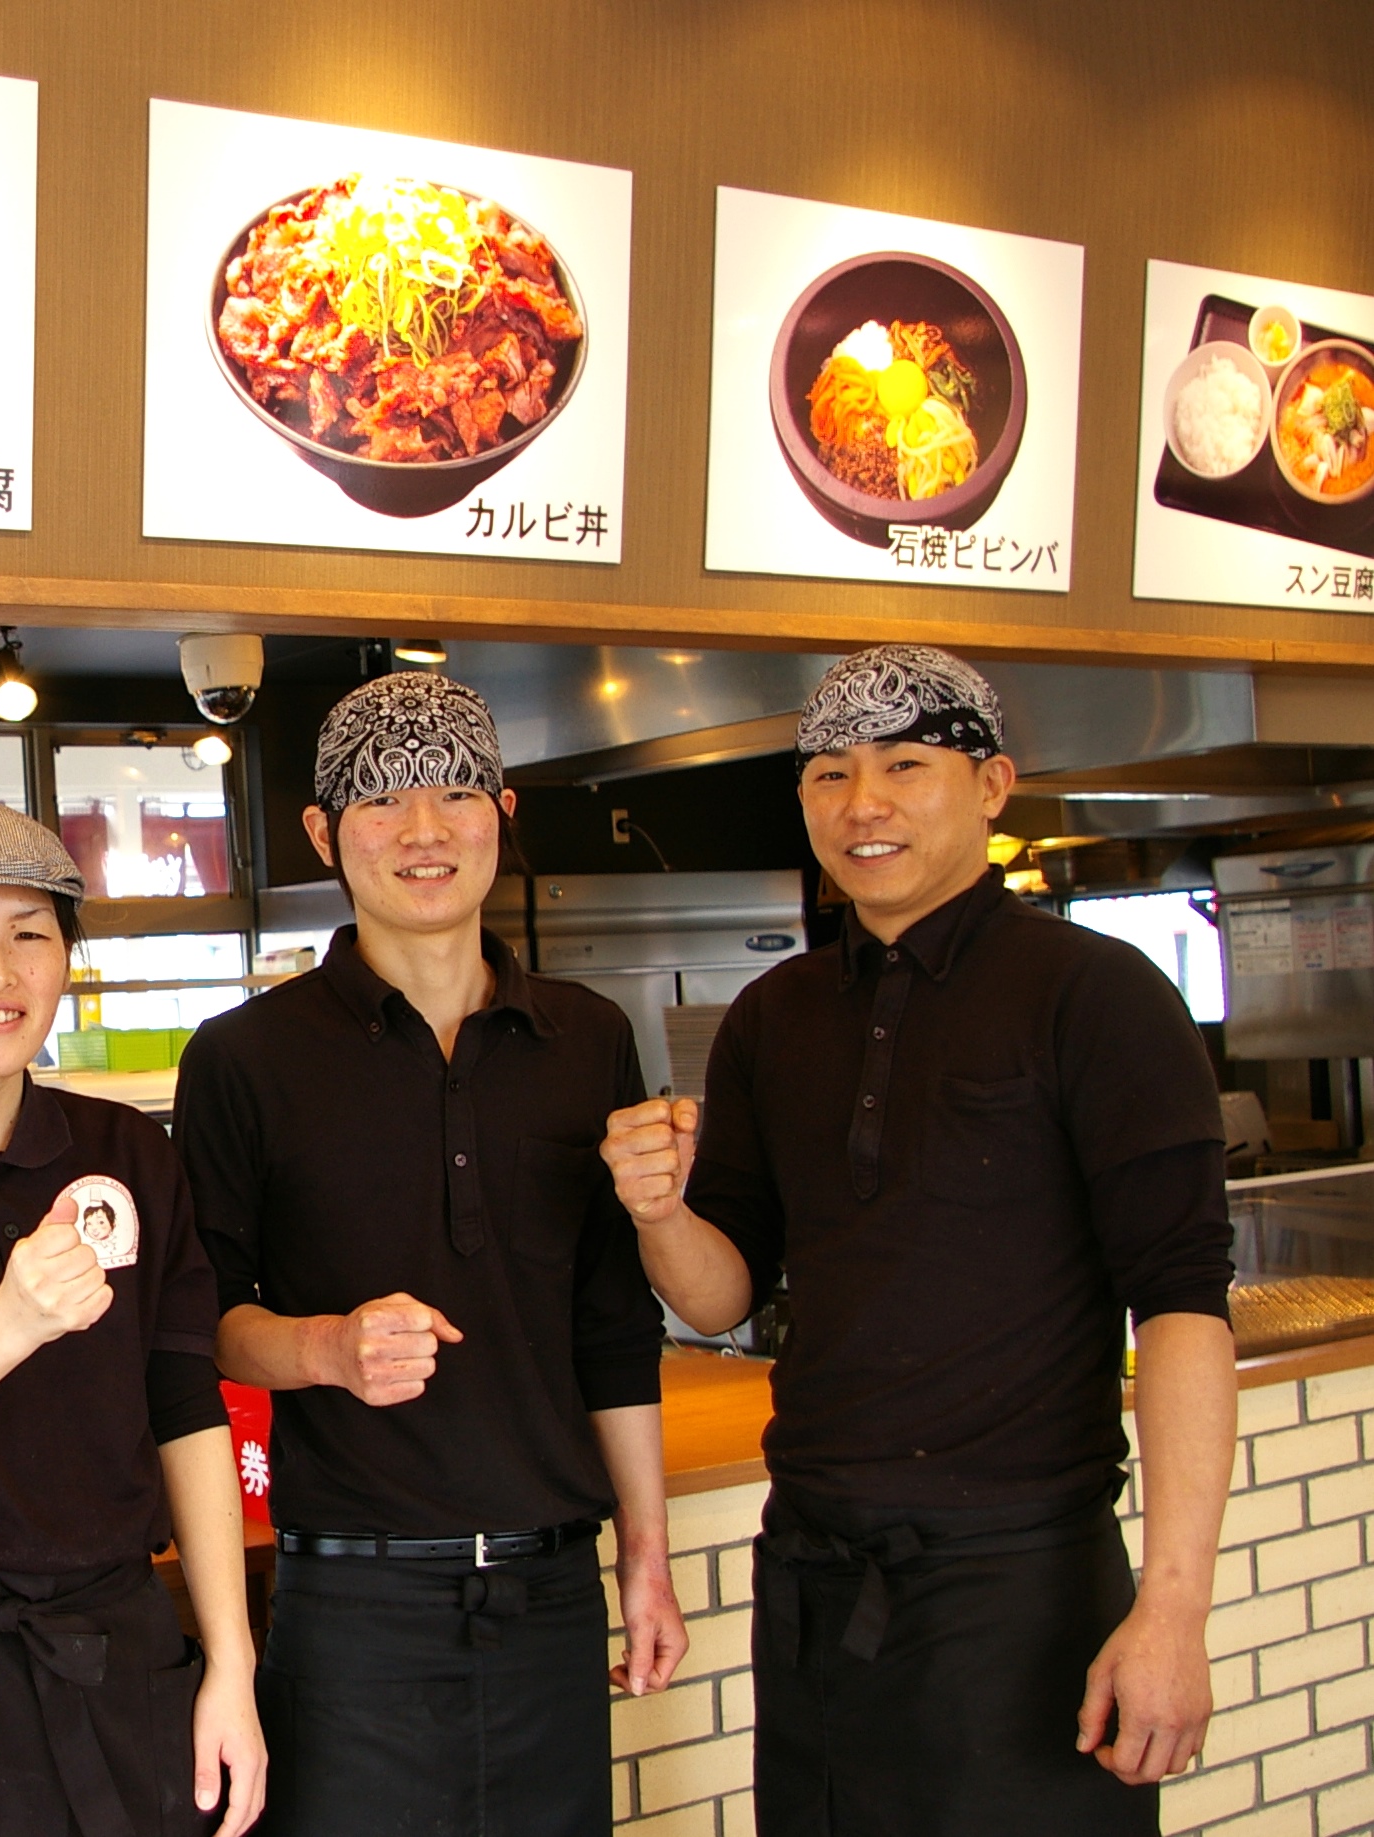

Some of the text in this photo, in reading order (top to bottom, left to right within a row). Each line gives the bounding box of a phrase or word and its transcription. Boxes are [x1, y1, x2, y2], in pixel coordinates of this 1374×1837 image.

[465, 498, 609, 547] カルビ丼
[890, 529, 1060, 574] 石焼ピビンバ
[1285, 565, 1374, 601] スン豆腐
[240, 1440, 270, 1497] 券
